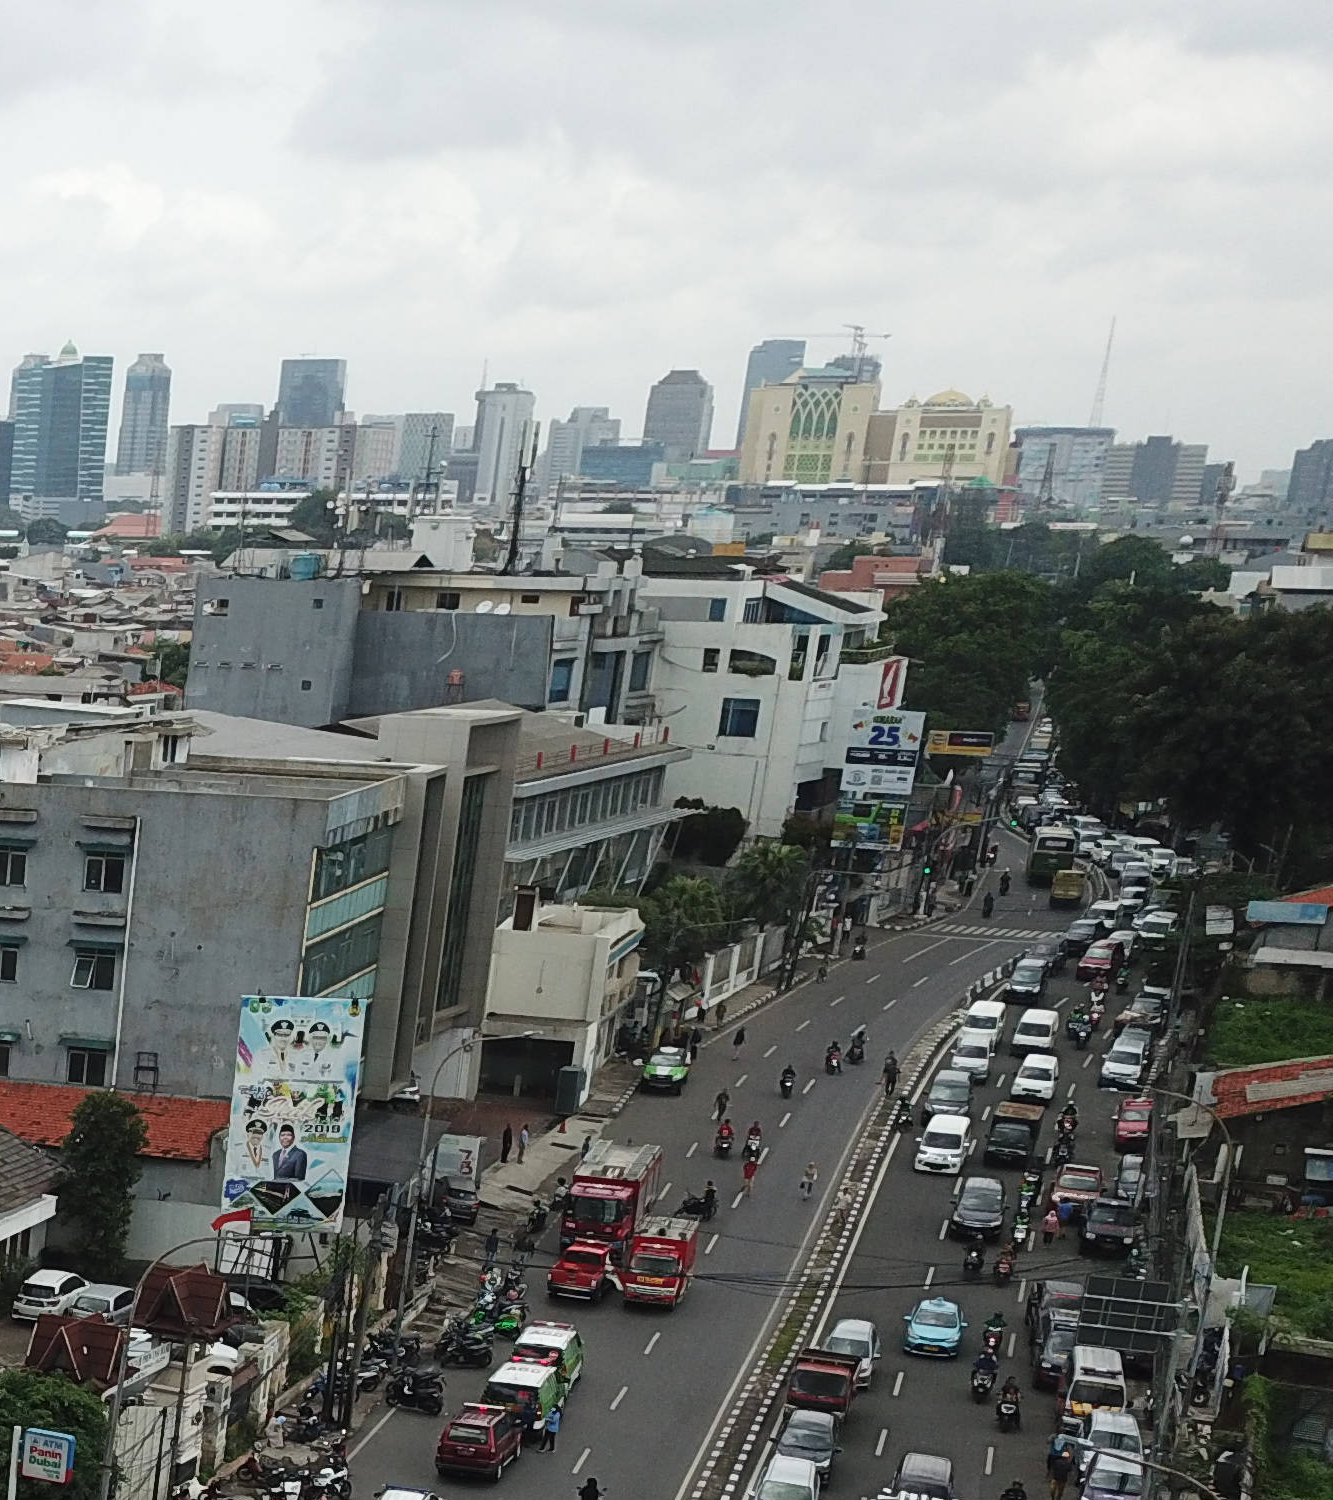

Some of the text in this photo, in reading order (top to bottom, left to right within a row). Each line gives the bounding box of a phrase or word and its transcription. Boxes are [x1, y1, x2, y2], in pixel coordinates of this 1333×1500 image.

[868, 725, 902, 747] 25
[43, 1439, 63, 1450] ATM
[29, 1445, 62, 1460] Panin
[28, 1455, 62, 1469] Dubai
